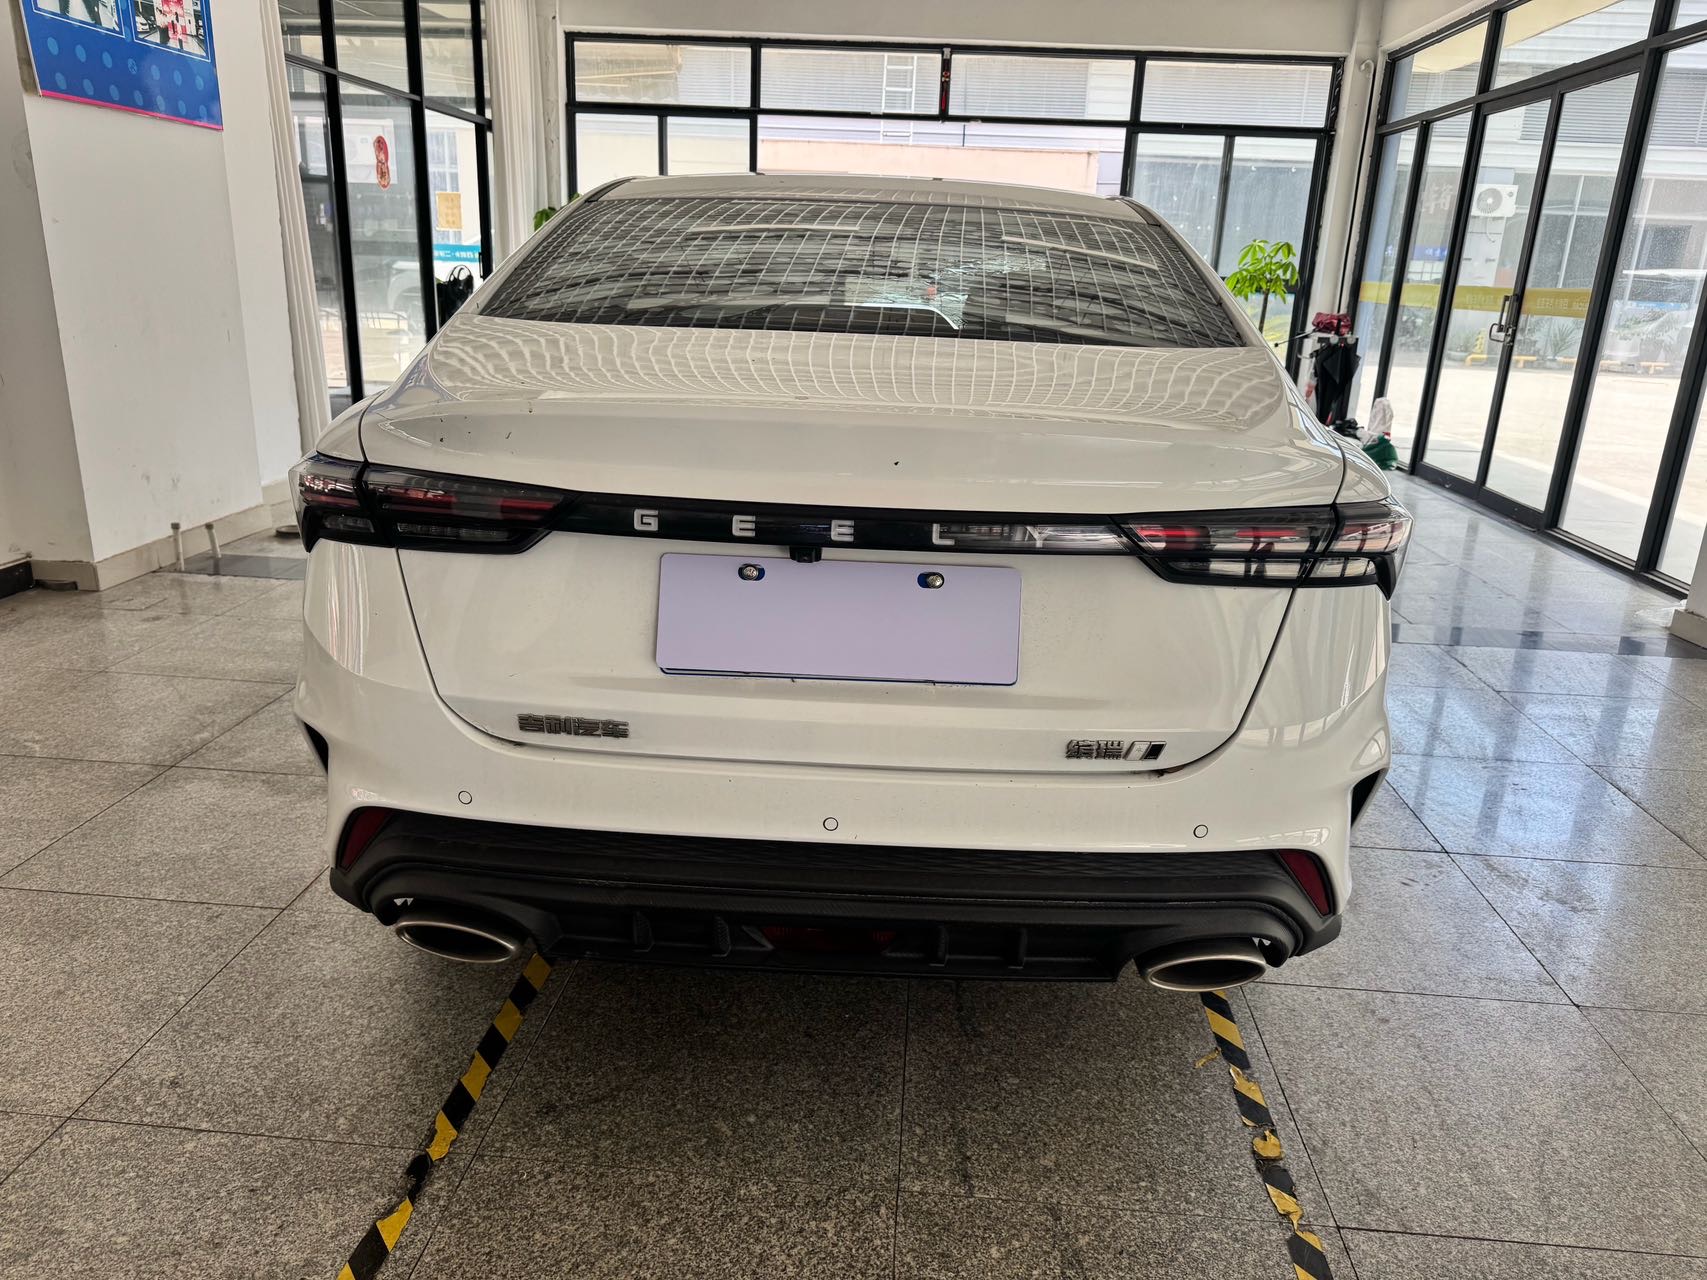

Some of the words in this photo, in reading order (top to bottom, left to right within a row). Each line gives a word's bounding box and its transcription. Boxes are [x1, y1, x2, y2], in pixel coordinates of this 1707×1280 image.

[633, 509, 1051, 548] GEELY
[517, 713, 630, 739] 吉利汽车
